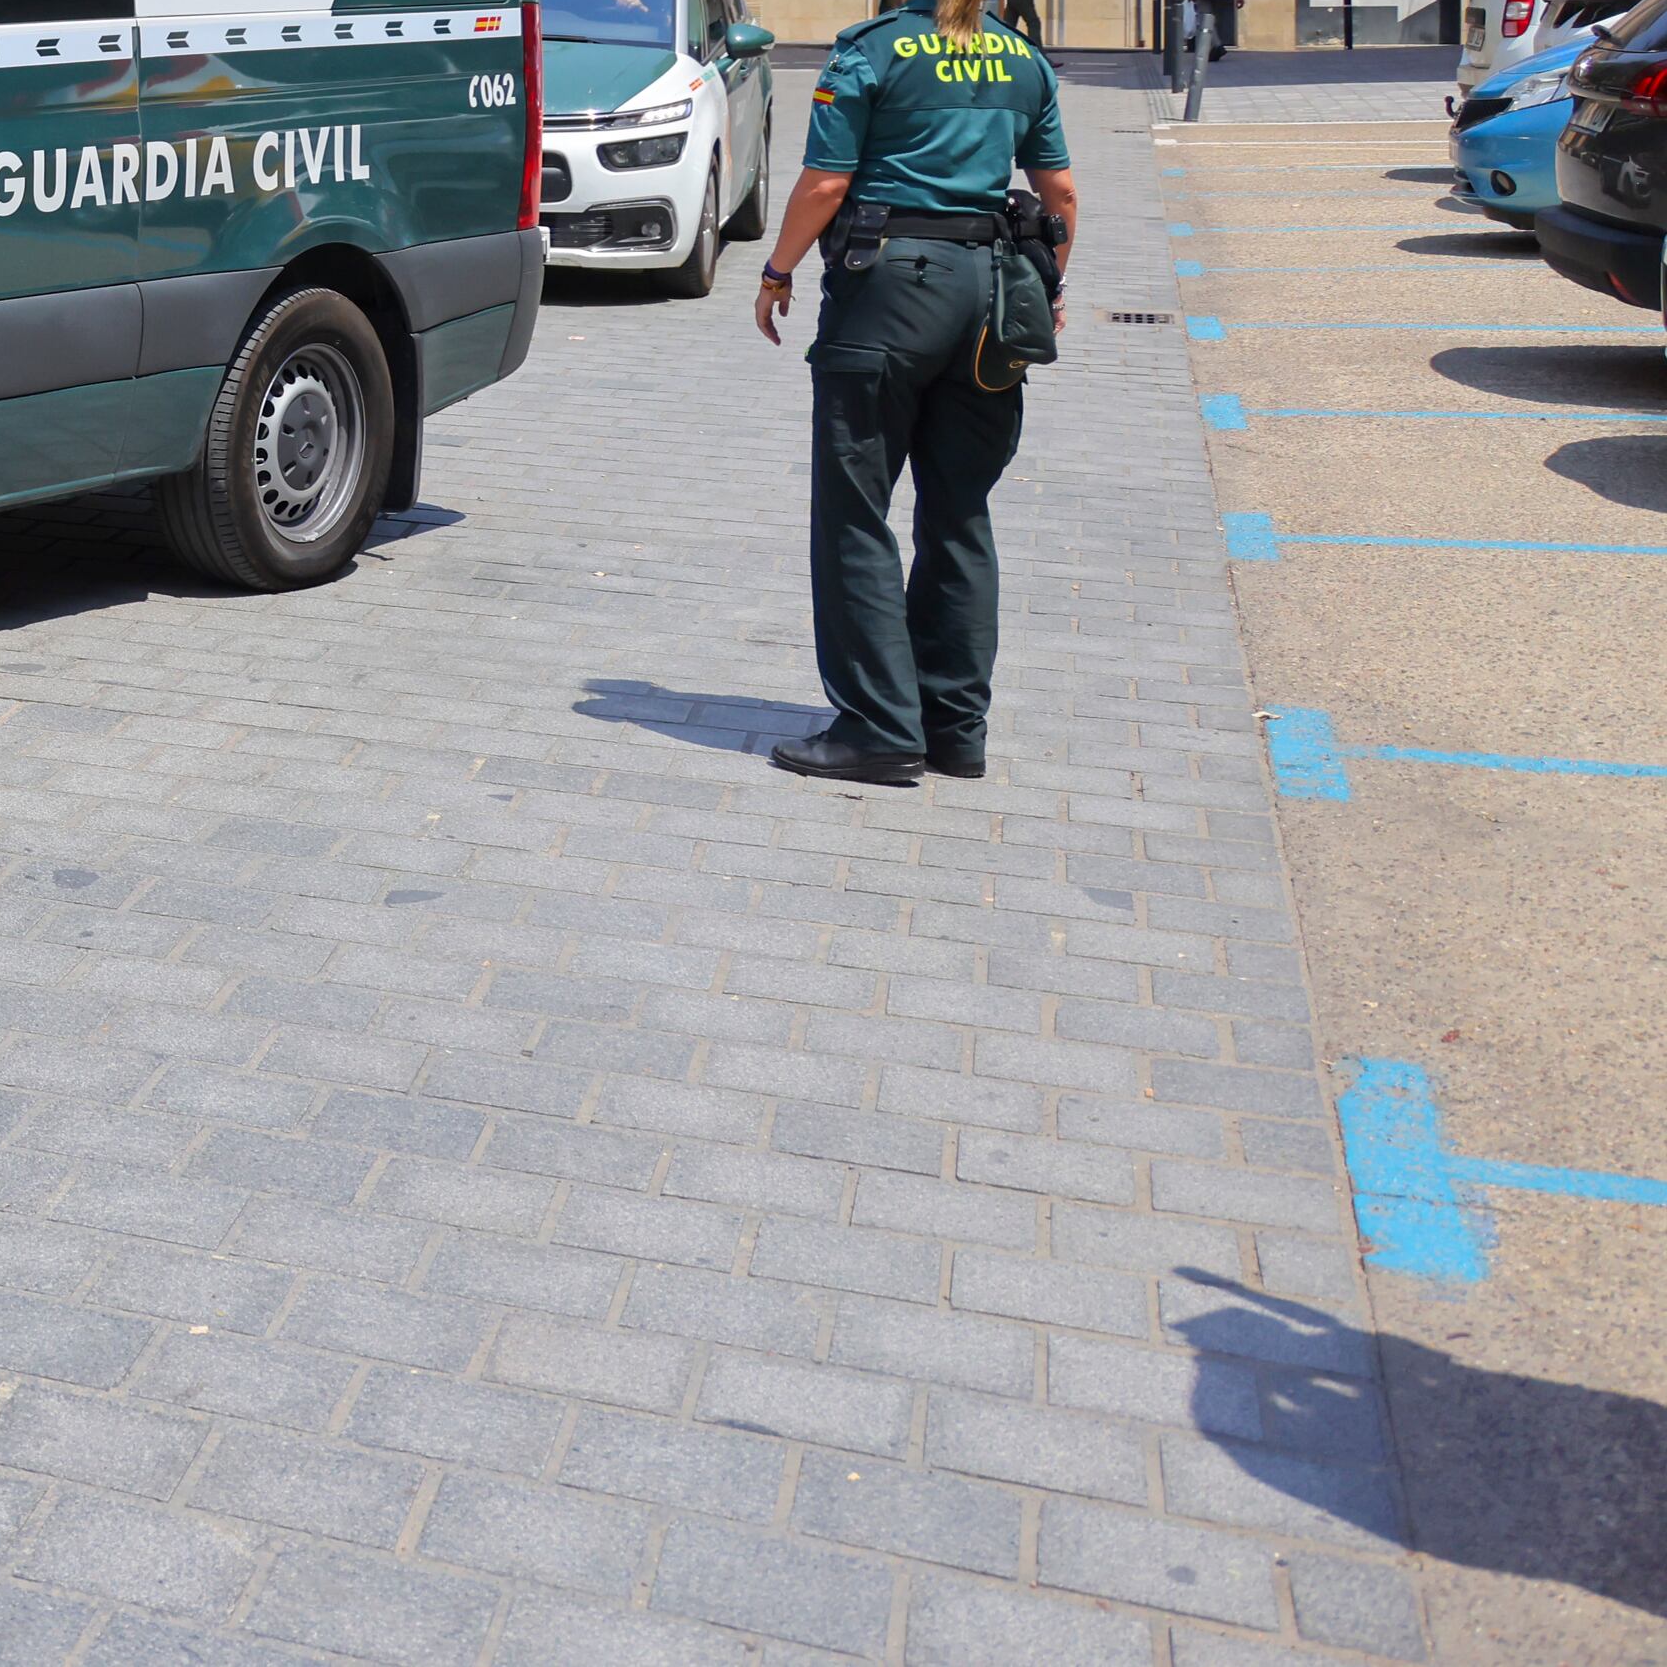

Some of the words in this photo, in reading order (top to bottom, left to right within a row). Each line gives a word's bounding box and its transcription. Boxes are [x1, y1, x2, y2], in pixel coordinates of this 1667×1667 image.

[935, 59, 1013, 83] CIVIL
[480, 72, 517, 108] 062
[252, 124, 370, 192] CIVIL
